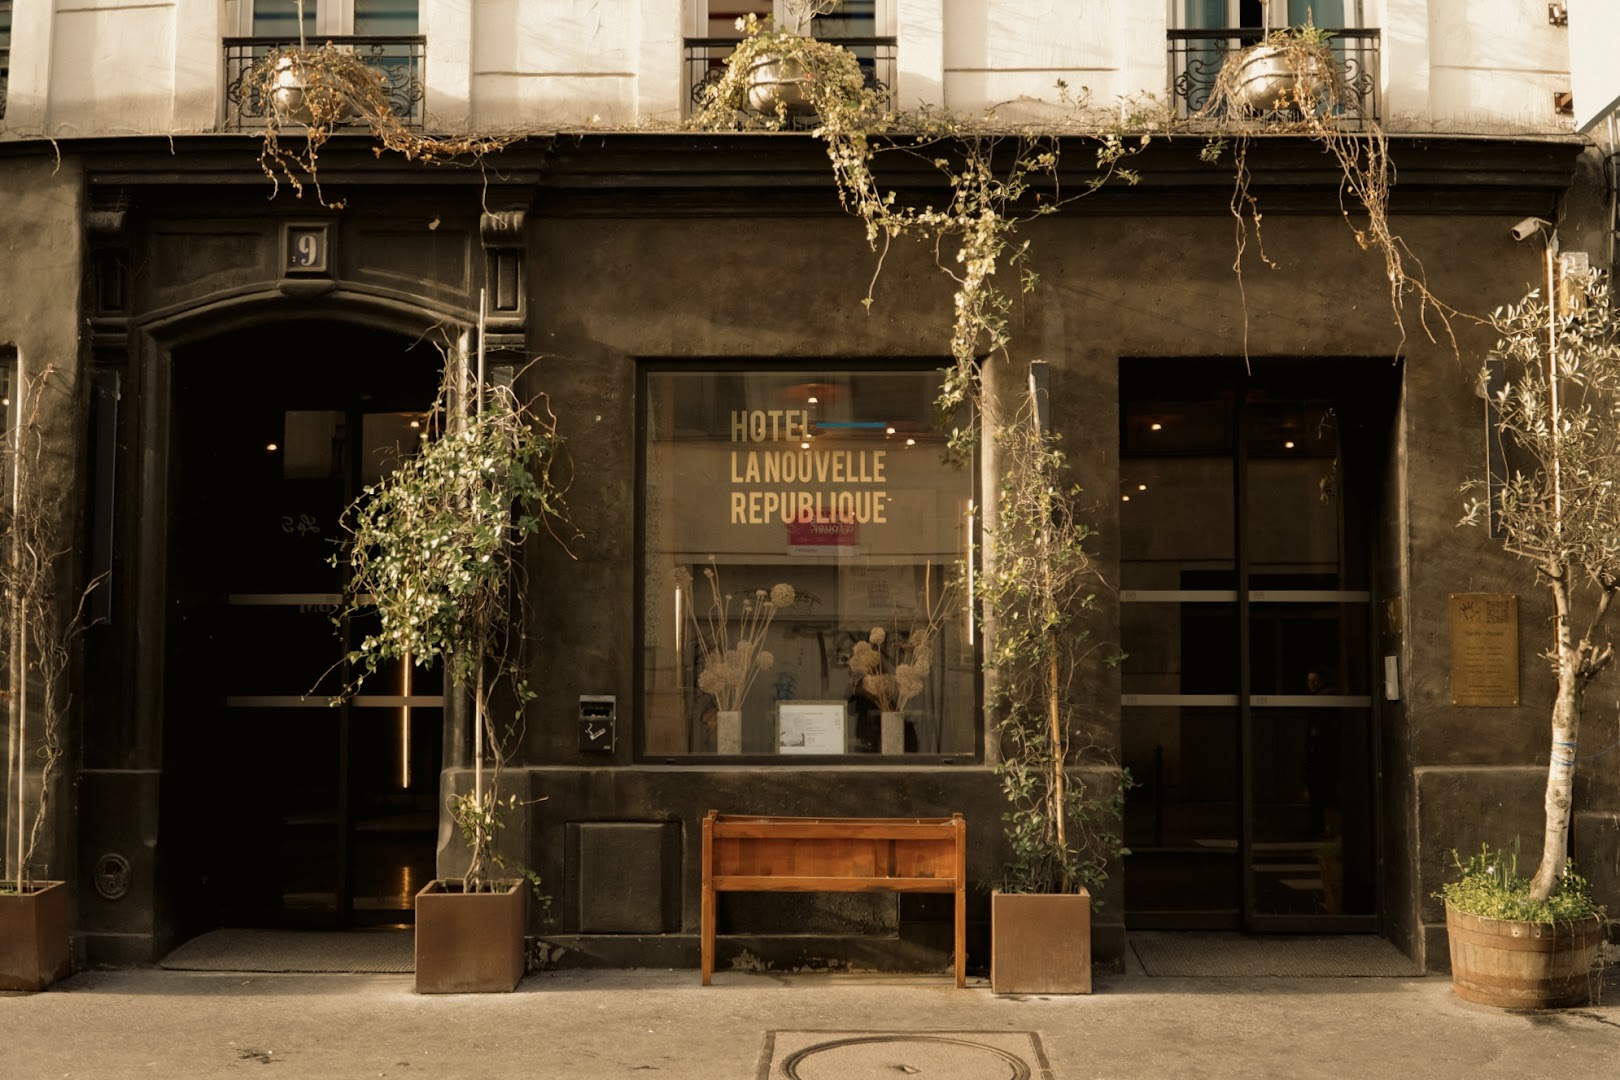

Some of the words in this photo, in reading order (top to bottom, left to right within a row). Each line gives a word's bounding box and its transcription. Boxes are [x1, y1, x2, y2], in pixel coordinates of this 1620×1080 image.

[298, 235, 317, 266] 9
[731, 410, 816, 443] HOTEL
[765, 451, 887, 483] NOUVELLE
[731, 491, 887, 524] REPUBLIQUE
